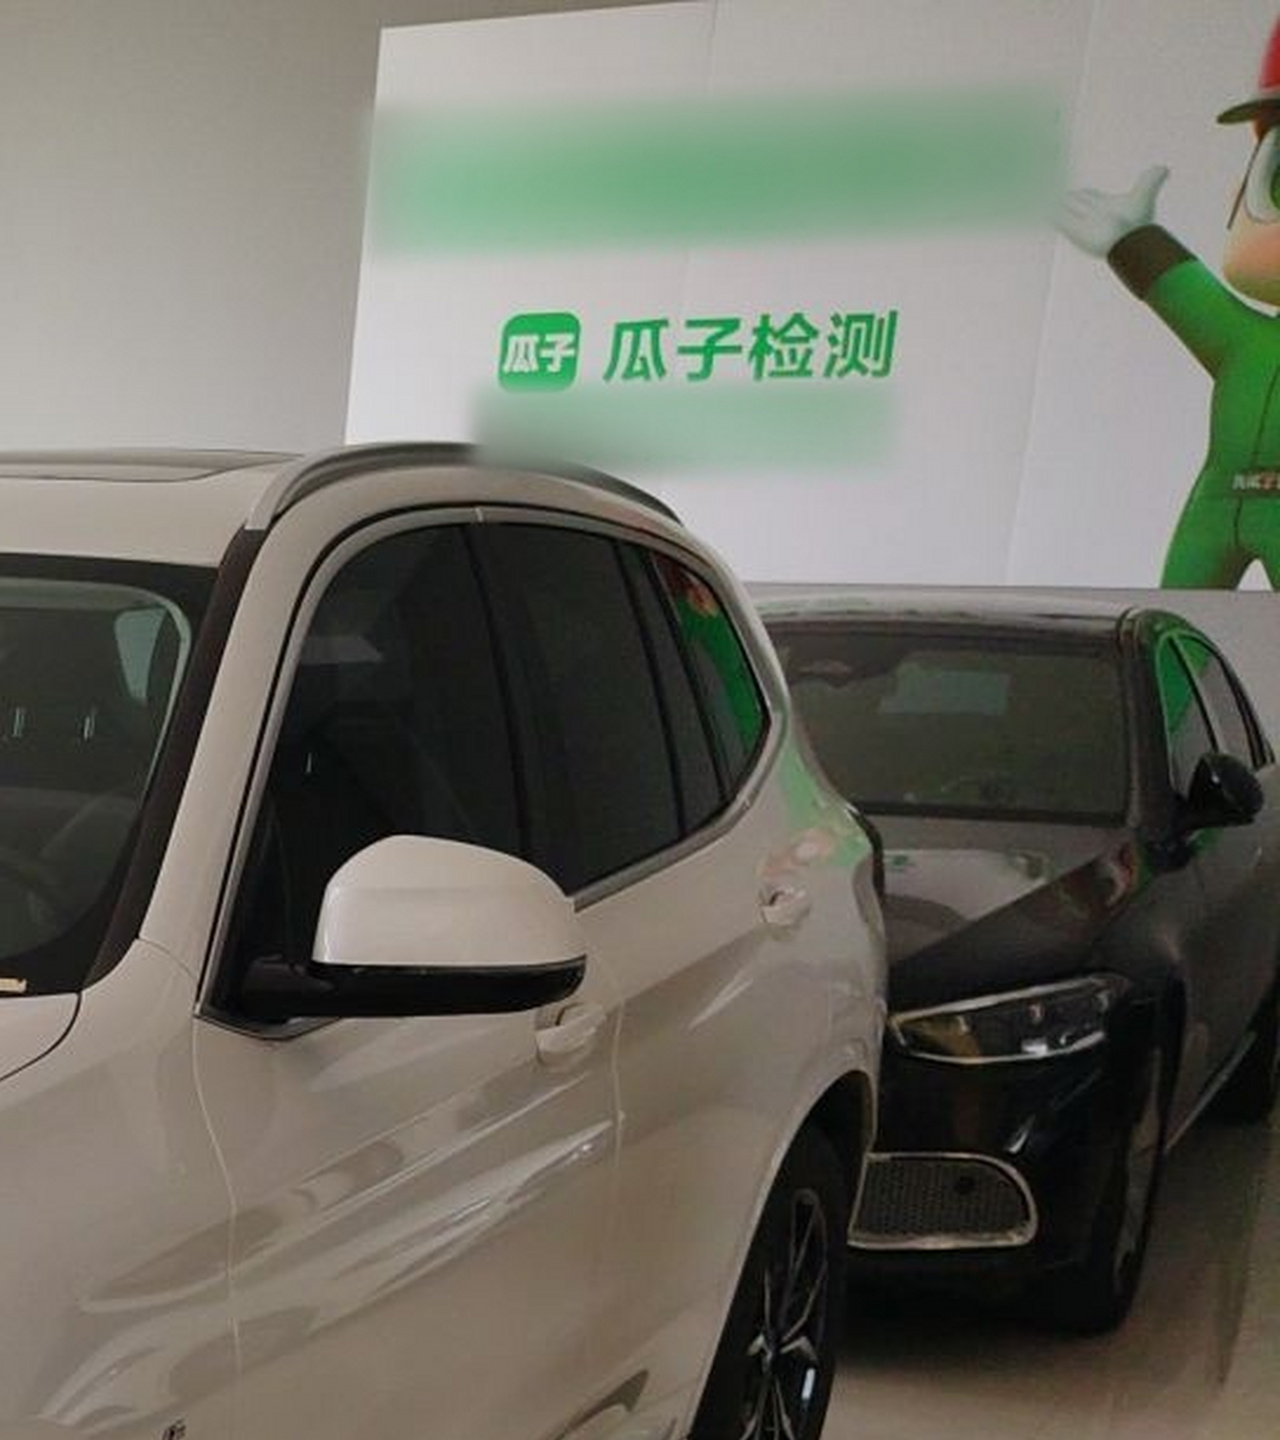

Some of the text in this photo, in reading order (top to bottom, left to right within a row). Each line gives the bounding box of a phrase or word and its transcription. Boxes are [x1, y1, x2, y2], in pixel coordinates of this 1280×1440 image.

[502, 335, 575, 373] 瓜子
[602, 310, 899, 382] 瓜子检测
